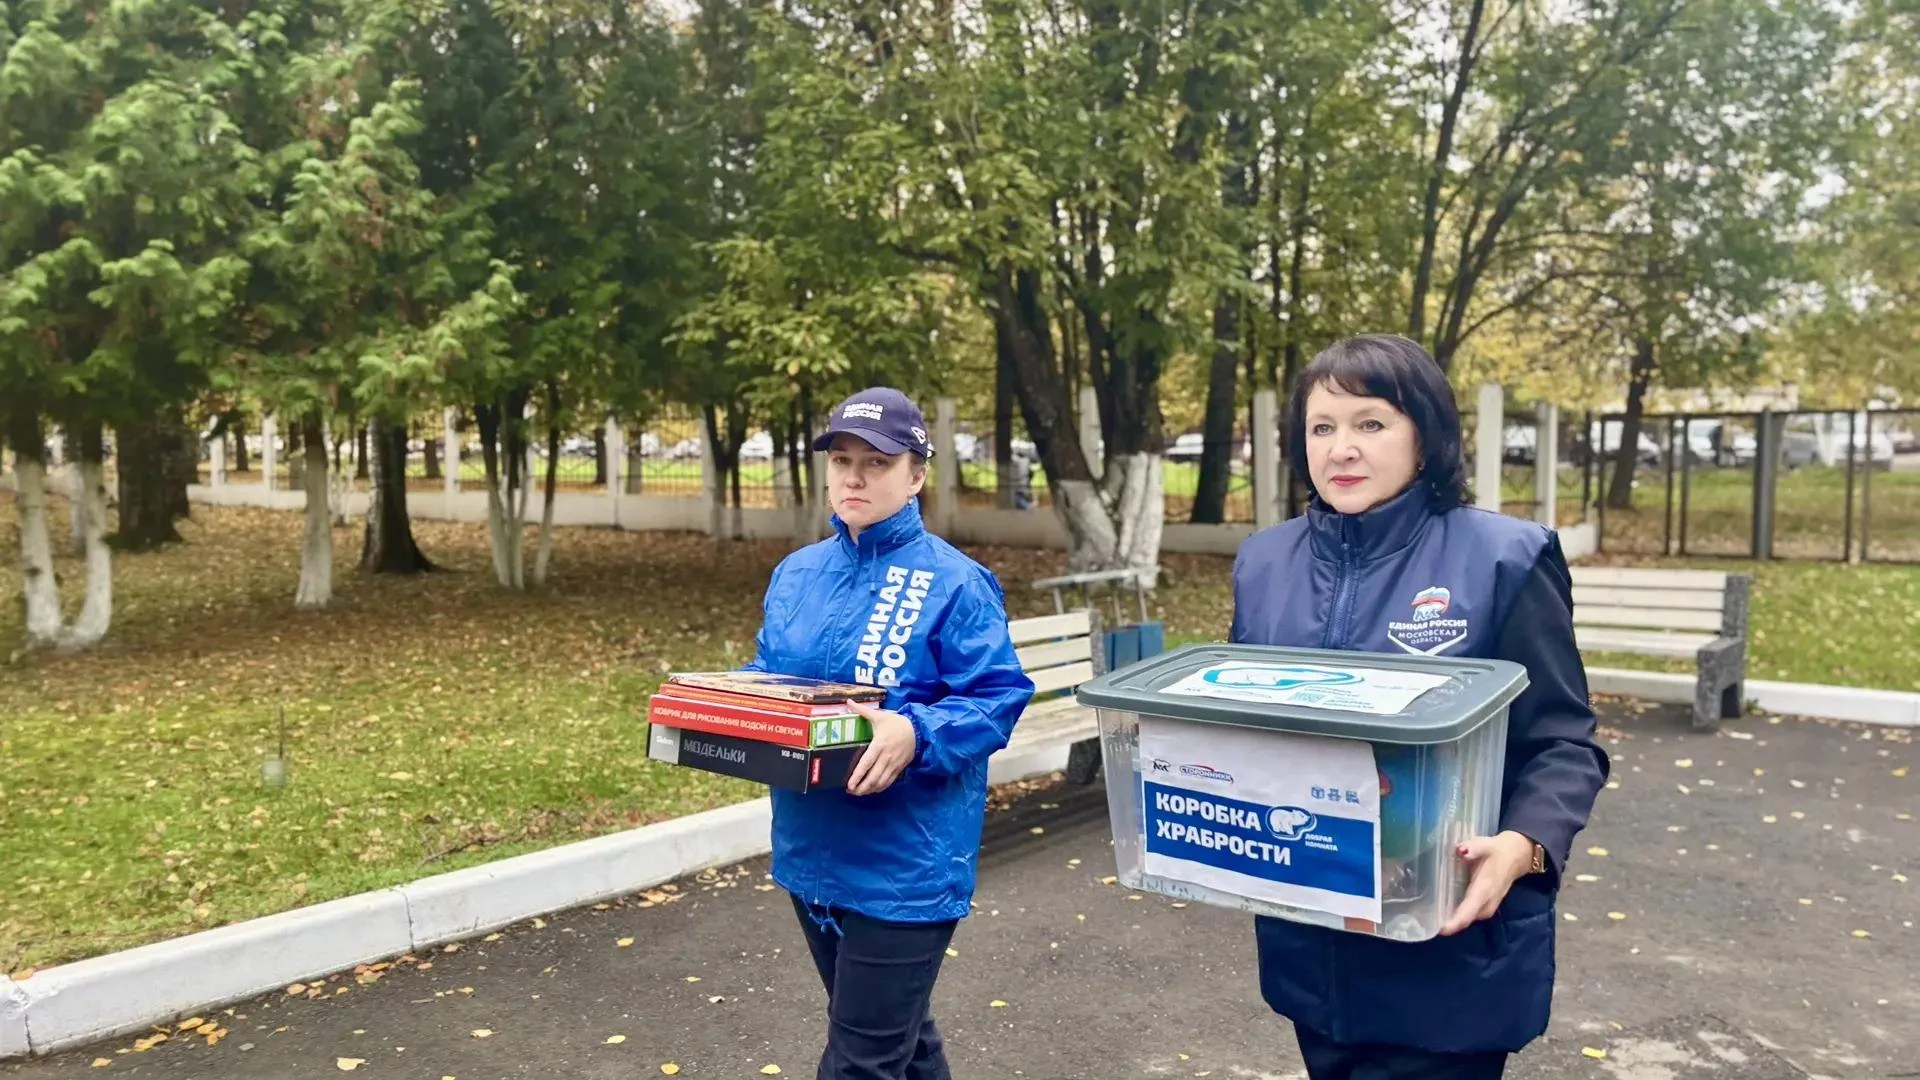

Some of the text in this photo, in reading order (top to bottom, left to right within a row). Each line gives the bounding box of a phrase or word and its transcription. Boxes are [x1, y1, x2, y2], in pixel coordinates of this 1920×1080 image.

[855, 565, 909, 685] ЕДИНАЯ
[878, 569, 935, 687] РОССИЯ
[1388, 619, 1468, 630] ЕДИНАЯ РОССИЯ
[1398, 629, 1457, 639] МОСКОВСКАЯ
[654, 706, 804, 737] КОВРИК ДЛЯ РИСОВАНИЯ ВОДОЙ И СВЕТОМ
[683, 738, 747, 764] МОДЕЛЬКИ
[1156, 791, 1262, 832] КОРОБКА
[1156, 819, 1292, 866] ХРАБРОСТИ
